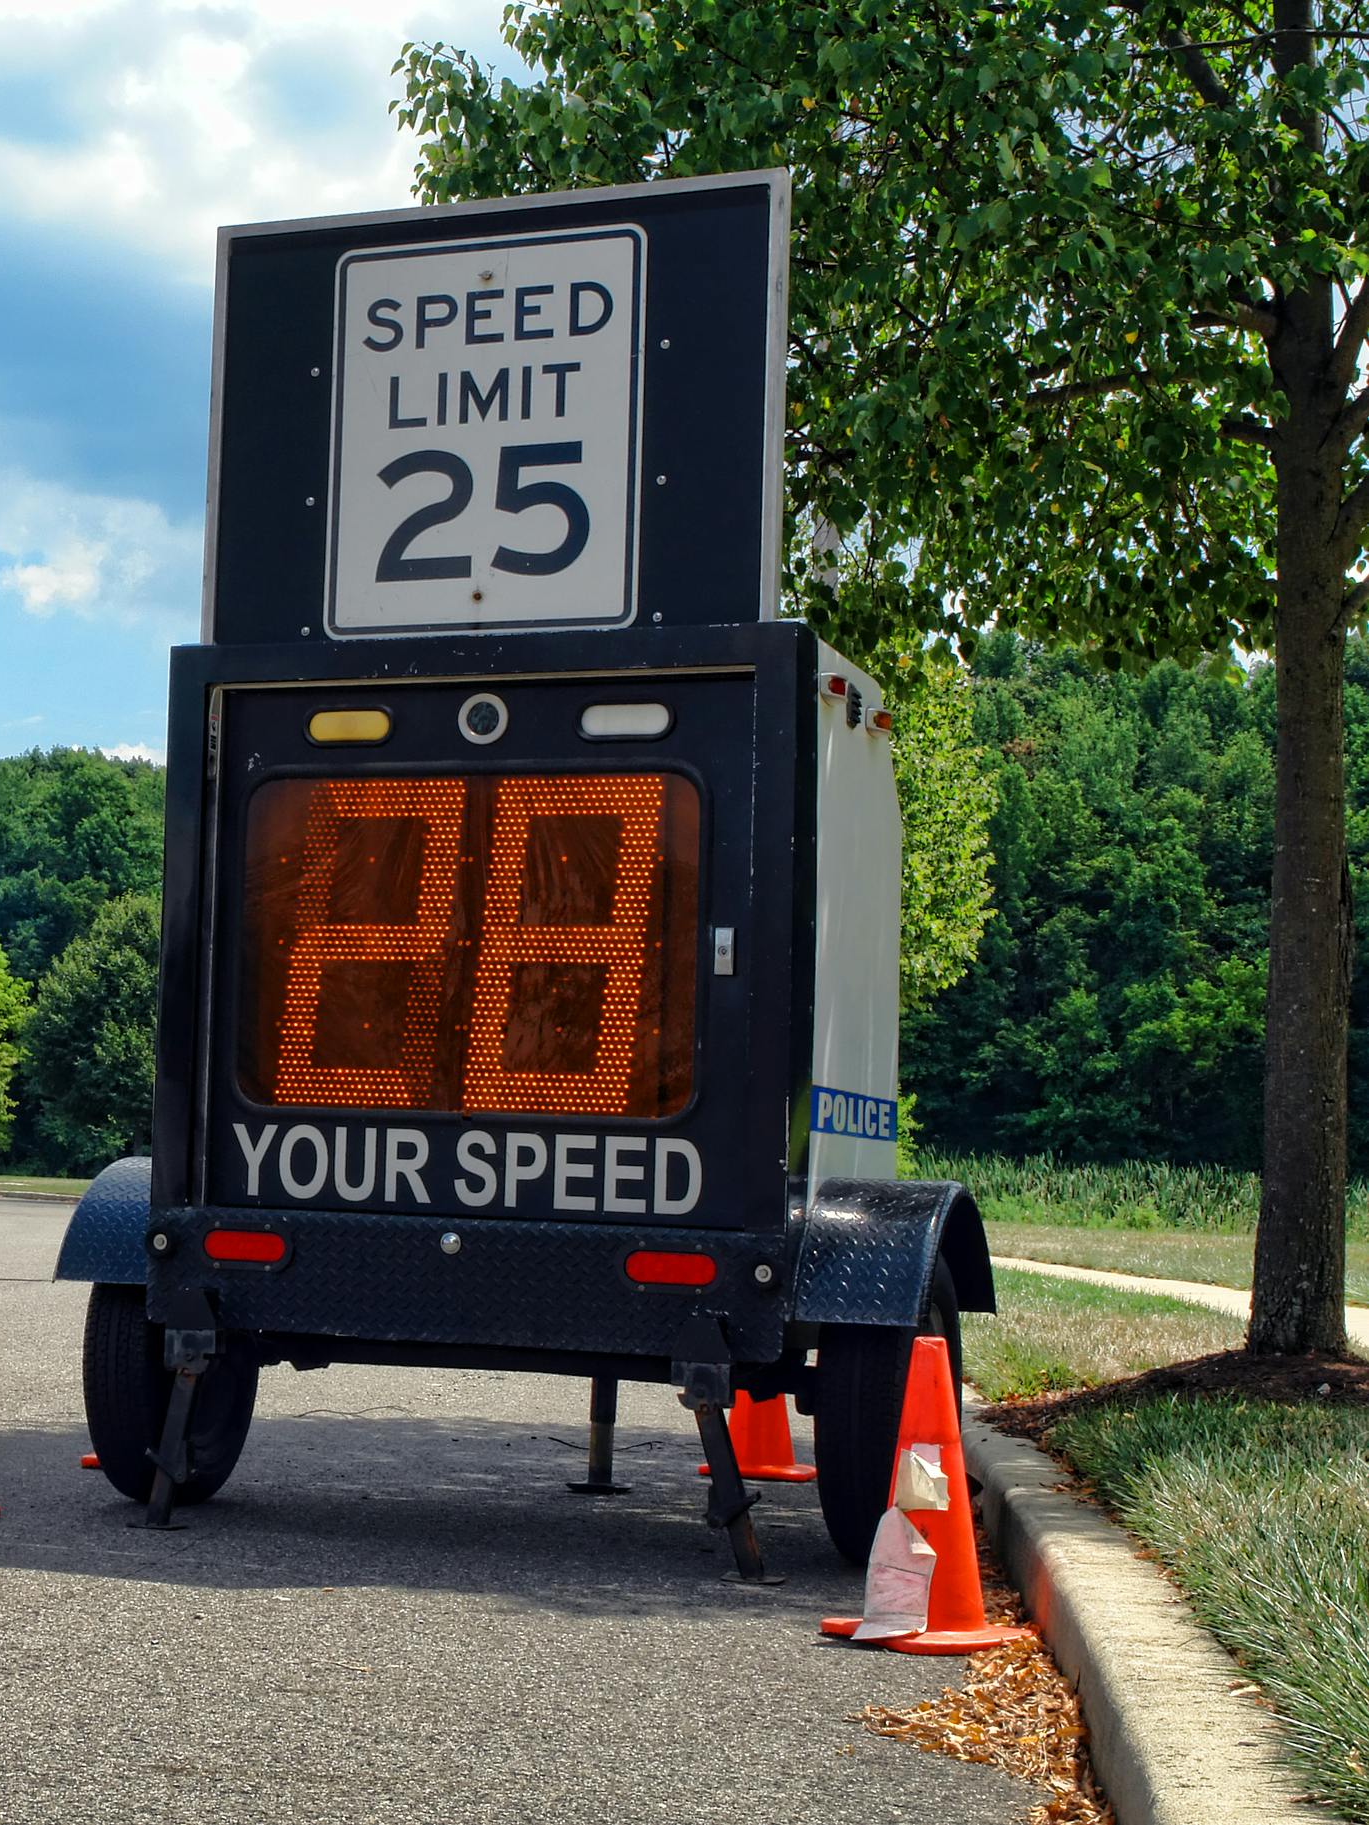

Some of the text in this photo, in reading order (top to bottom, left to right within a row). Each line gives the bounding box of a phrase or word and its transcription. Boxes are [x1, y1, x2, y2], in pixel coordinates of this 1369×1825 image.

[362, 281, 614, 353] SPEED
[388, 362, 582, 430] LIMIT
[375, 440, 590, 584] 25
[817, 1091, 891, 1138] POLICE
[231, 1122, 703, 1216] YOUR SPEED
